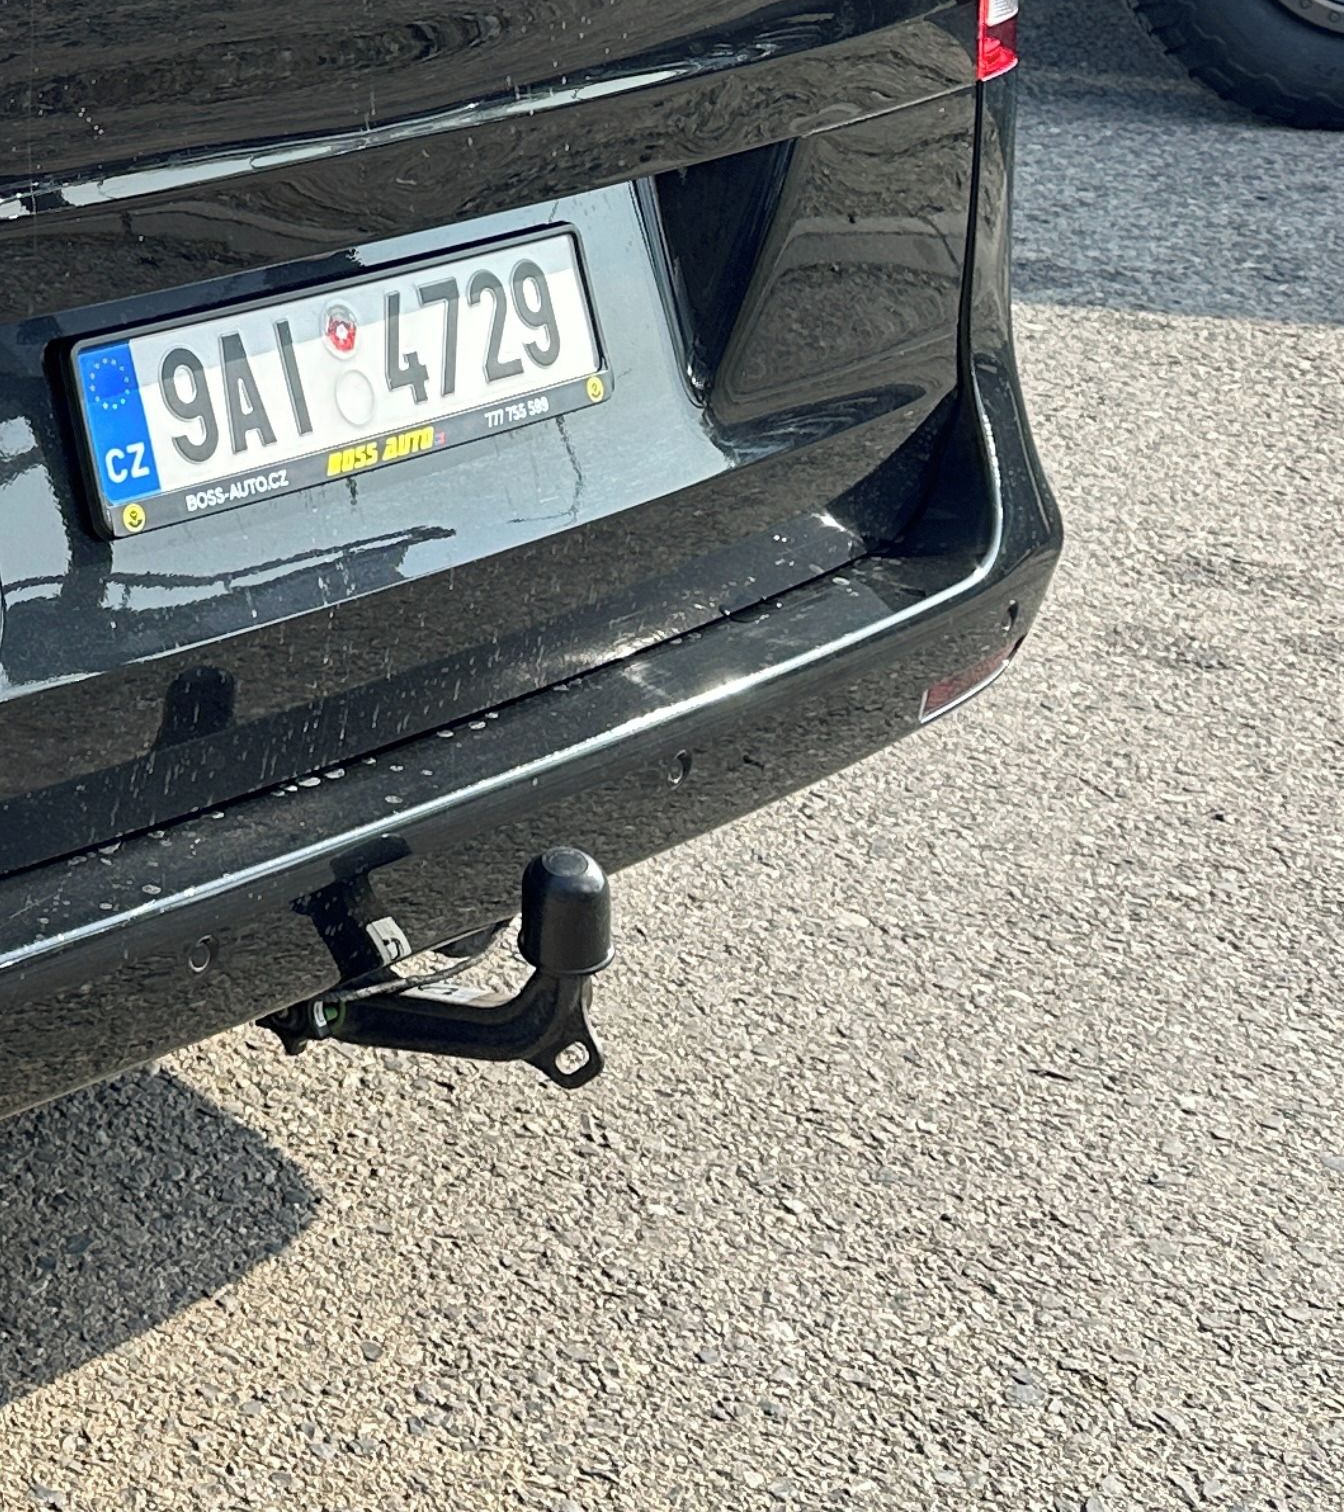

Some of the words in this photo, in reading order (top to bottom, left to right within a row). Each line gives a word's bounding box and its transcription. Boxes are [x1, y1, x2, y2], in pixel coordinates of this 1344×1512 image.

[159, 317, 314, 465] 9AI
[384, 258, 561, 405] 4729
[484, 409, 505, 428] 777
[105, 442, 151, 484] CZ
[326, 441, 379, 477] BOSS
[382, 426, 435, 461] AUTO
[185, 469, 290, 512] BOSS-AUTO.CZ
